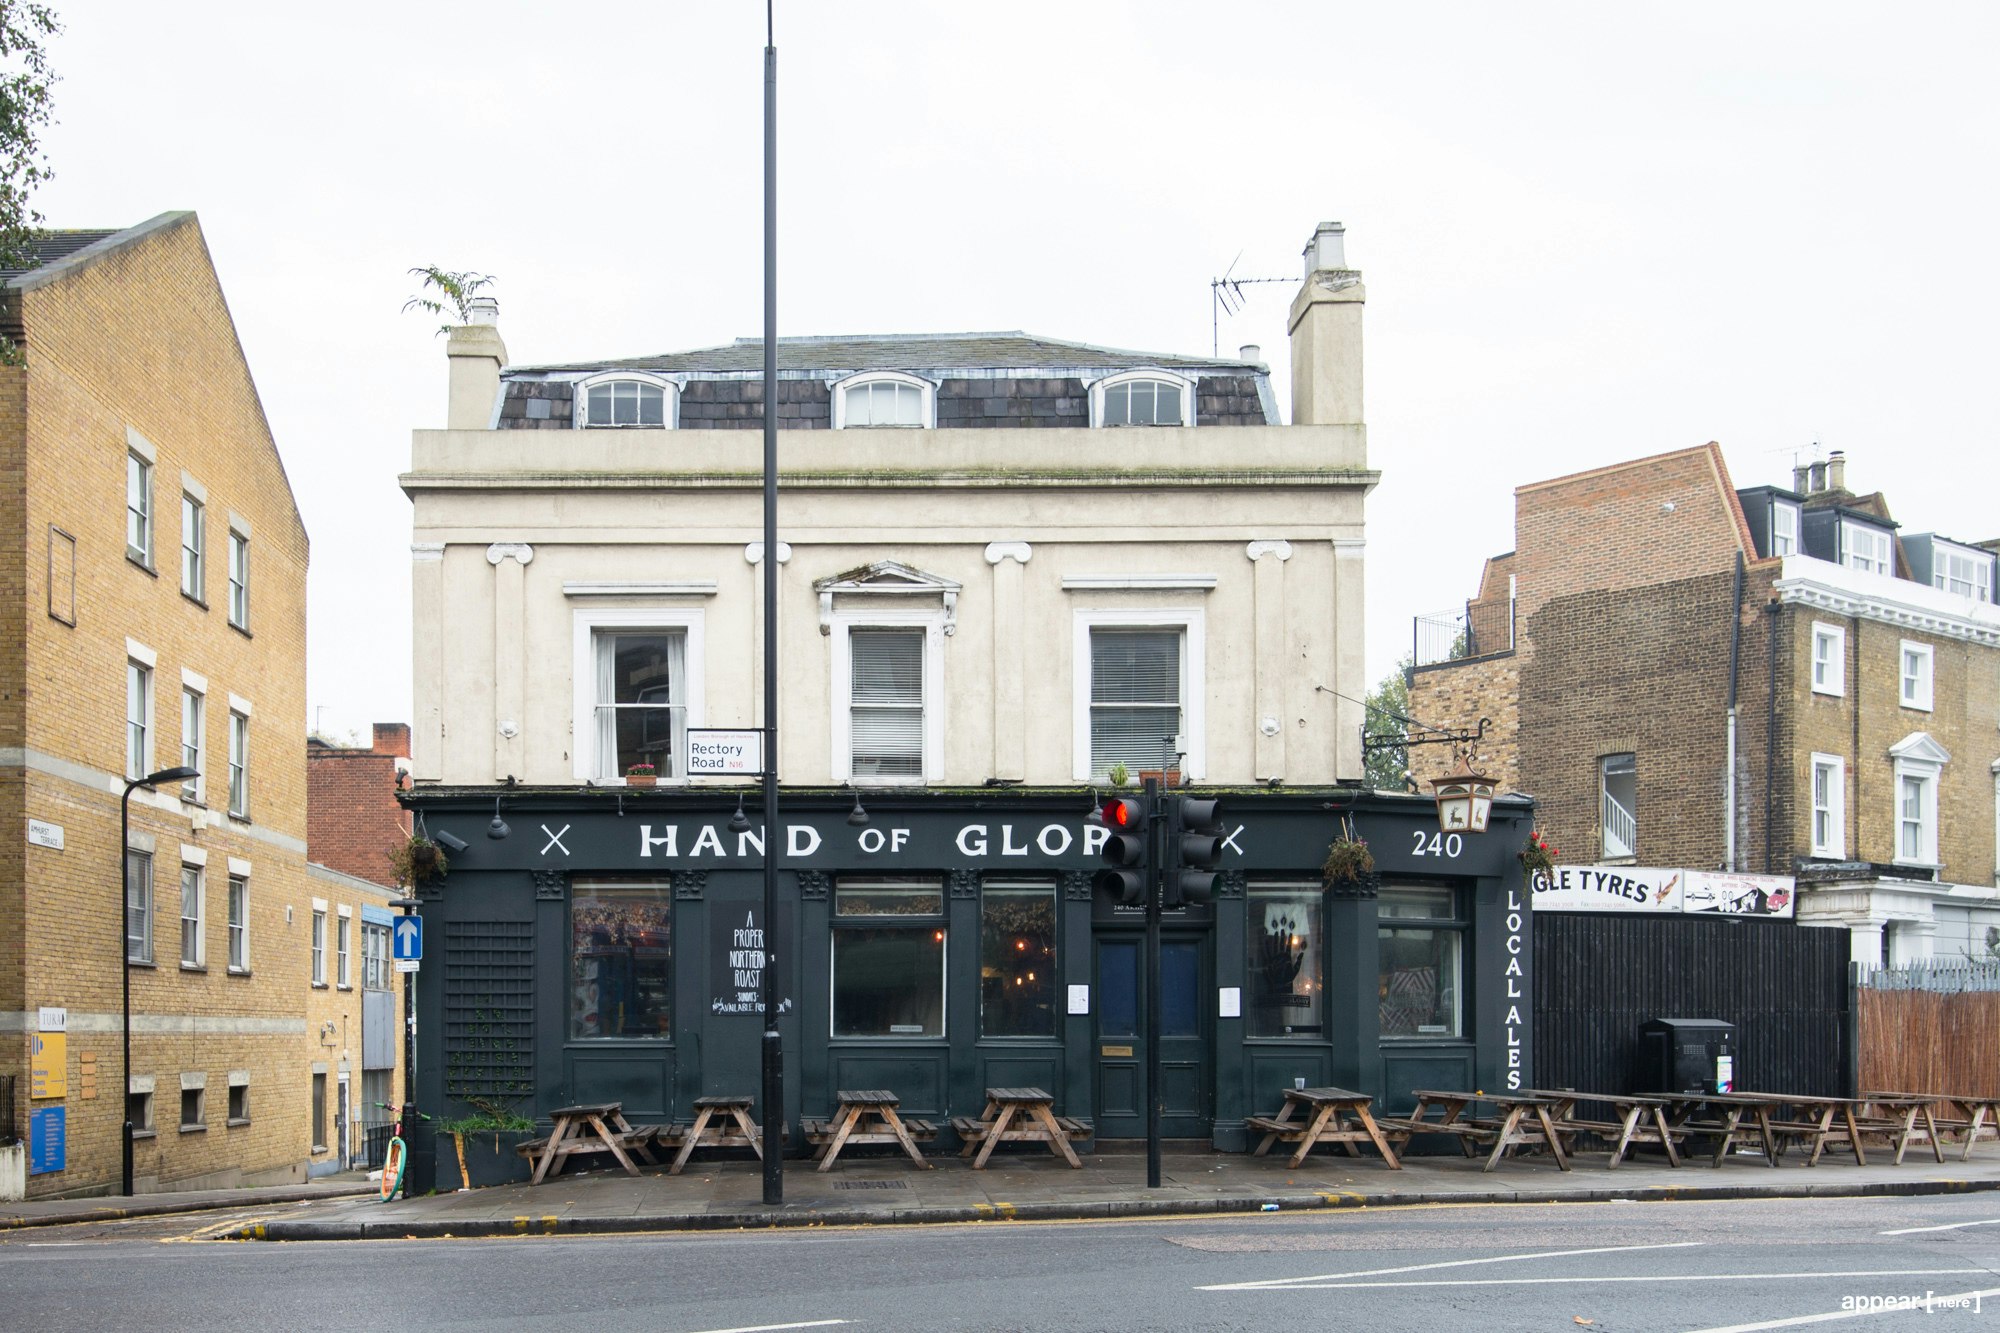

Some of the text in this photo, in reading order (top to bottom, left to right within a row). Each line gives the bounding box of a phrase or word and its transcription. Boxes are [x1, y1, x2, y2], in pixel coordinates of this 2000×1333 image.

[692, 743, 743, 756] Rectory
[692, 757, 724, 768] Road
[640, 824, 1112, 857] HAND OF GLOR
[1412, 831, 1462, 858] 240
[1532, 870, 1649, 903] GLE TYRES
[746, 910, 754, 928] A
[734, 929, 764, 948] PROPER
[734, 970, 760, 988] ROAST
[1505, 890, 1522, 1090] LOCAL ALES
